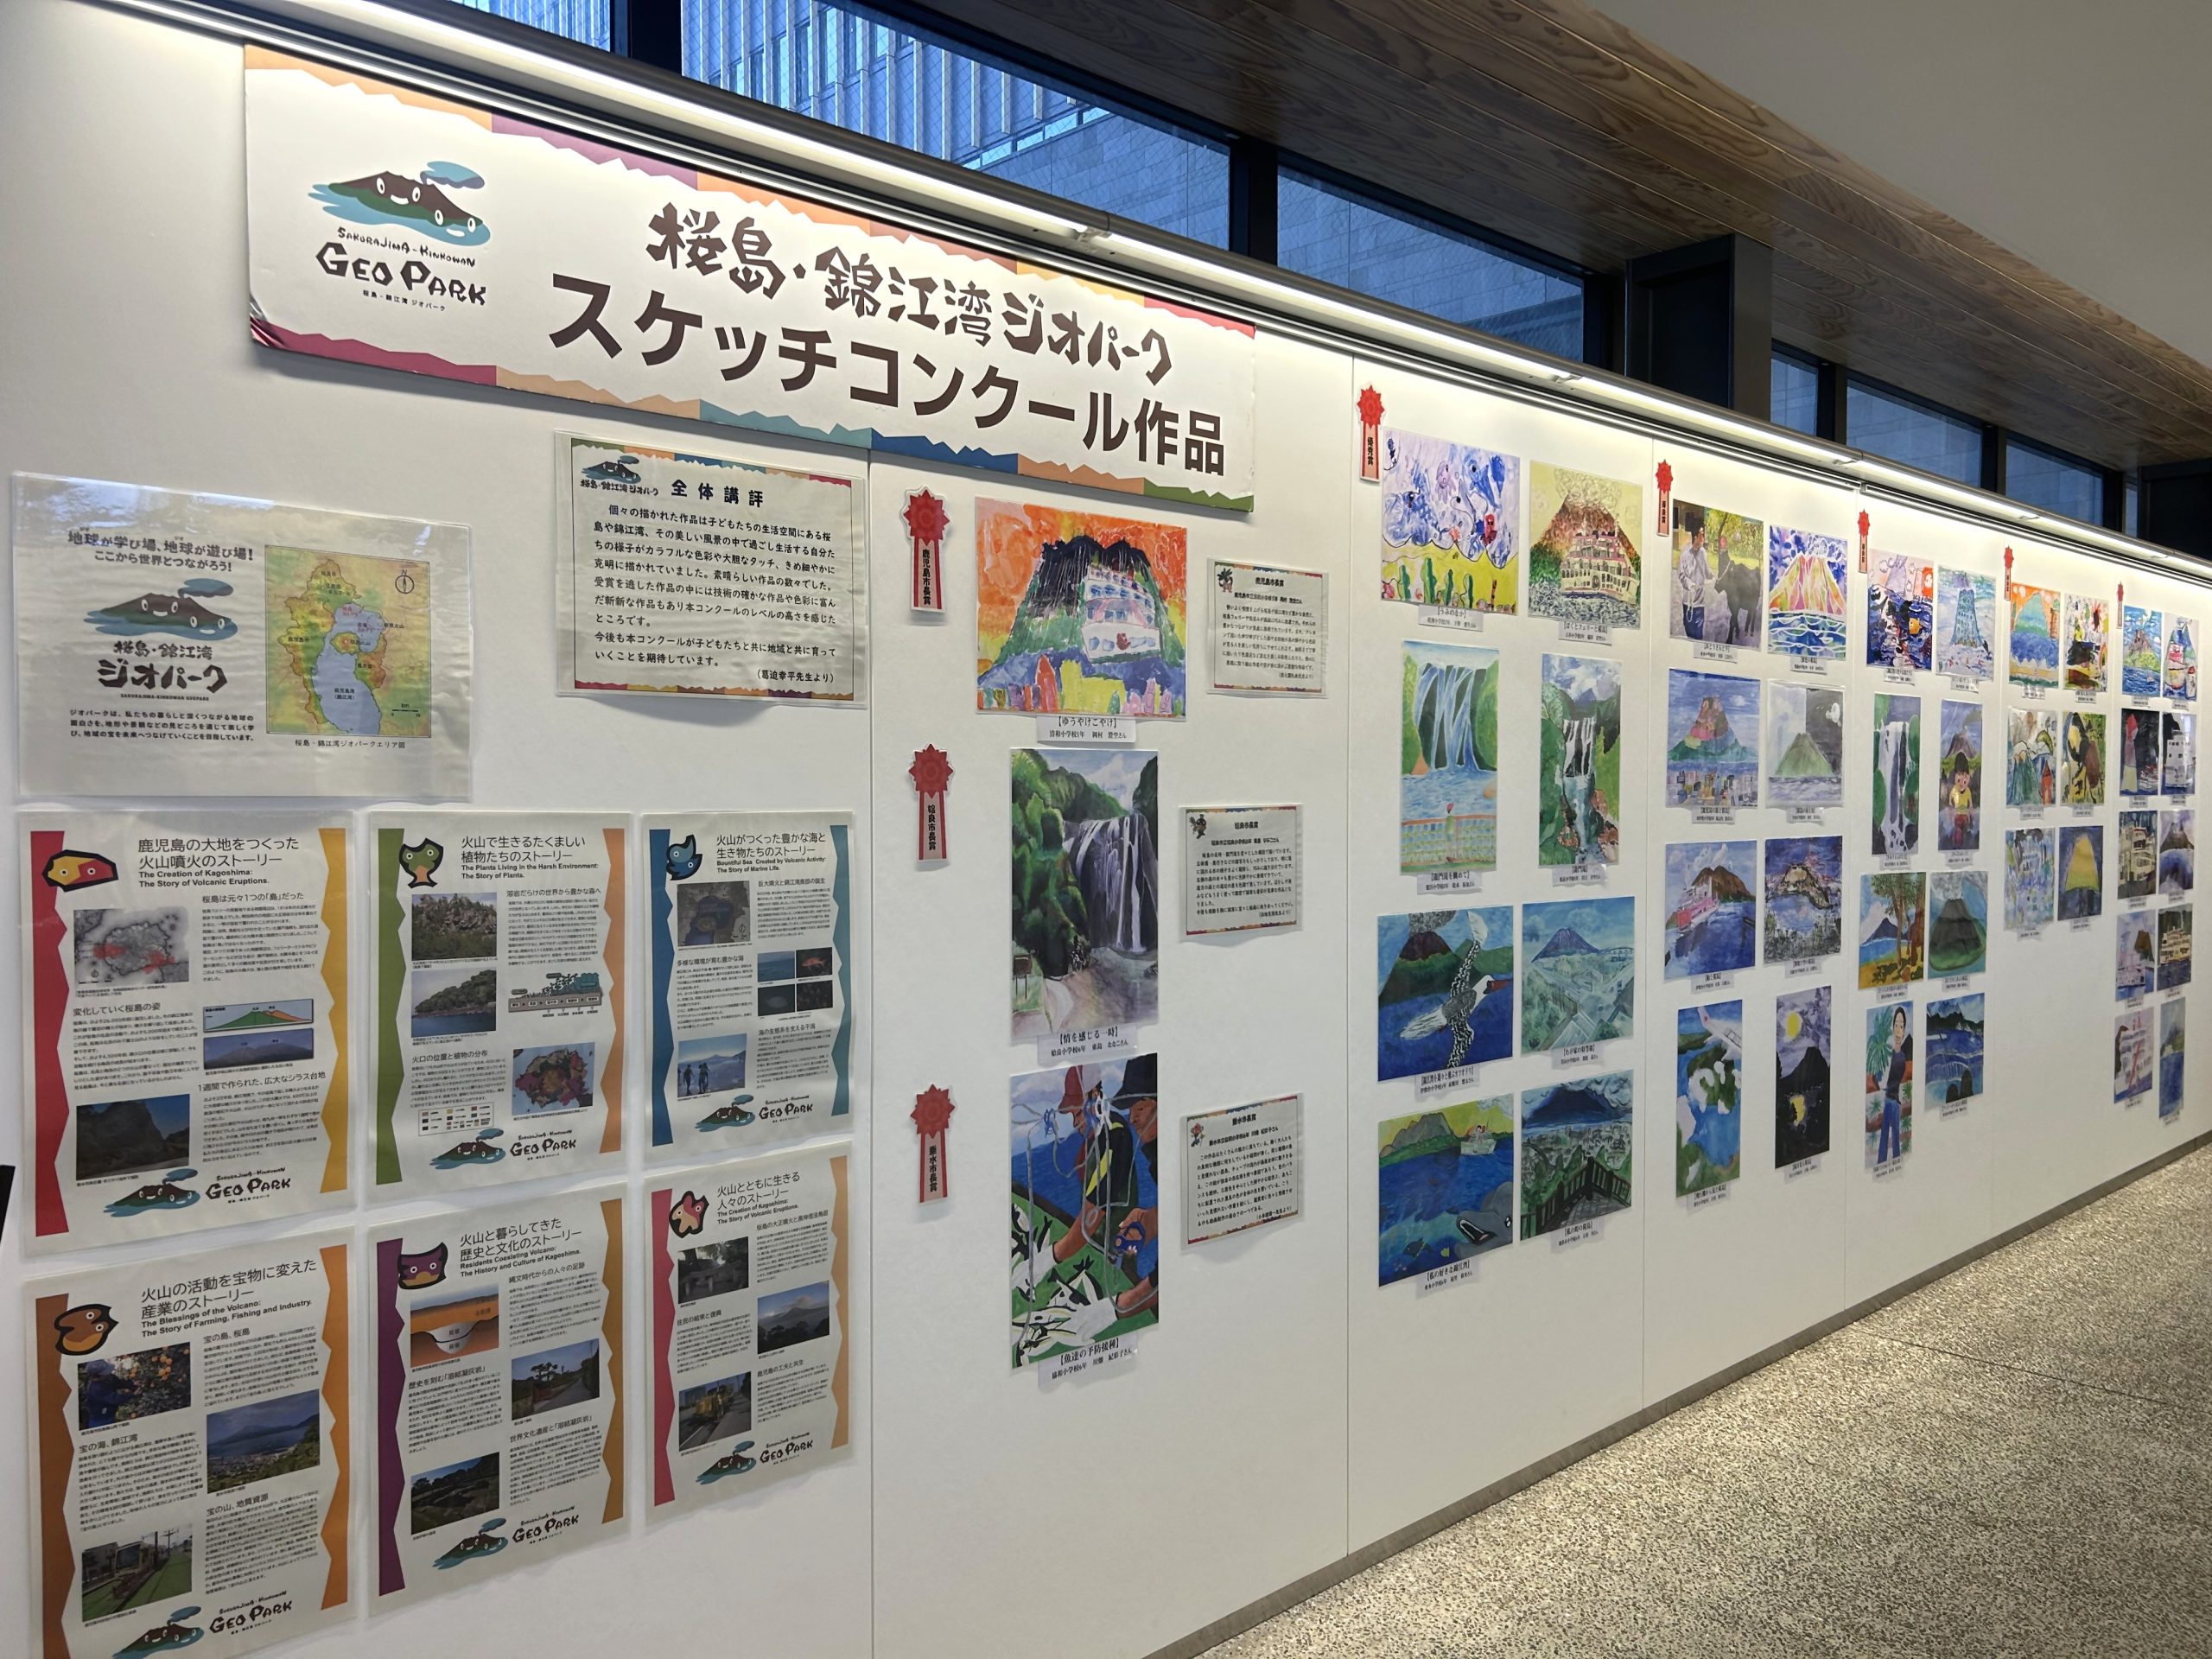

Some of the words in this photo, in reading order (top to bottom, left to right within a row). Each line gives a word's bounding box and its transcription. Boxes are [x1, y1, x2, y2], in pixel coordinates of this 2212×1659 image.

[316, 242, 394, 287] GEO
[401, 261, 486, 306] PARK
[646, 201, 1173, 385] 桜島・錦江湾ジオパーク
[548, 273, 1225, 477] スケッチコンクール作品
[671, 480, 764, 508] 全体講評
[595, 614, 652, 627] ところです。
[114, 640, 213, 660] 桜島・錦江湾
[595, 651, 719, 667] いくことを期待しています。
[97, 658, 227, 693] ジオパーク
[138, 837, 299, 853] 鹿児島の大地をつくった
[461, 836, 585, 849] 火山で生きるたくましい
[717, 833, 826, 846] 火山がつくった豊かな海と
[139, 854, 282, 869] 火山噴火のストーリー
[461, 851, 573, 863] 植物たちのストーリー
[717, 846, 816, 858] 生き物たちのストーリー
[73, 1002, 161, 1016] 変化していく桜島の姿
[759, 1105, 782, 1120] GEO
[785, 1103, 813, 1115] PARK
[510, 1139, 539, 1156] GEO
[542, 1135, 576, 1152] PARK
[206, 1180, 244, 1199] GEO
[247, 1178, 291, 1194] PARK
[717, 1172, 799, 1198] 火山とともに生きる
[717, 1188, 788, 1211] 人々のストーリー
[729, 1206, 751, 1215] Creation
[461, 1218, 562, 1247] 火山と暮らしてきた
[461, 1229, 582, 1262] 歴史と文化のストーリー
[461, 1259, 493, 1269] Residents
[475, 1265, 498, 1274] History
[513, 1257, 536, 1267] Culture
[142, 1259, 316, 1302] 火山の活動を宝物に変えた
[142, 1289, 254, 1319] 産業のストーリー
[143, 1329, 157, 1338] The
[160, 1325, 181, 1334] Story
[232, 1309, 260, 1320] Fishing
[264, 1305, 277, 1314] and
[160, 1312, 200, 1325] Blessings
[760, 1449, 784, 1464] GEO
[785, 1440, 813, 1455] PARK
[512, 1525, 541, 1543] GEO
[544, 1515, 579, 1533] PARK
[209, 1613, 246, 1634] GEO
[249, 1600, 293, 1623] PARK
